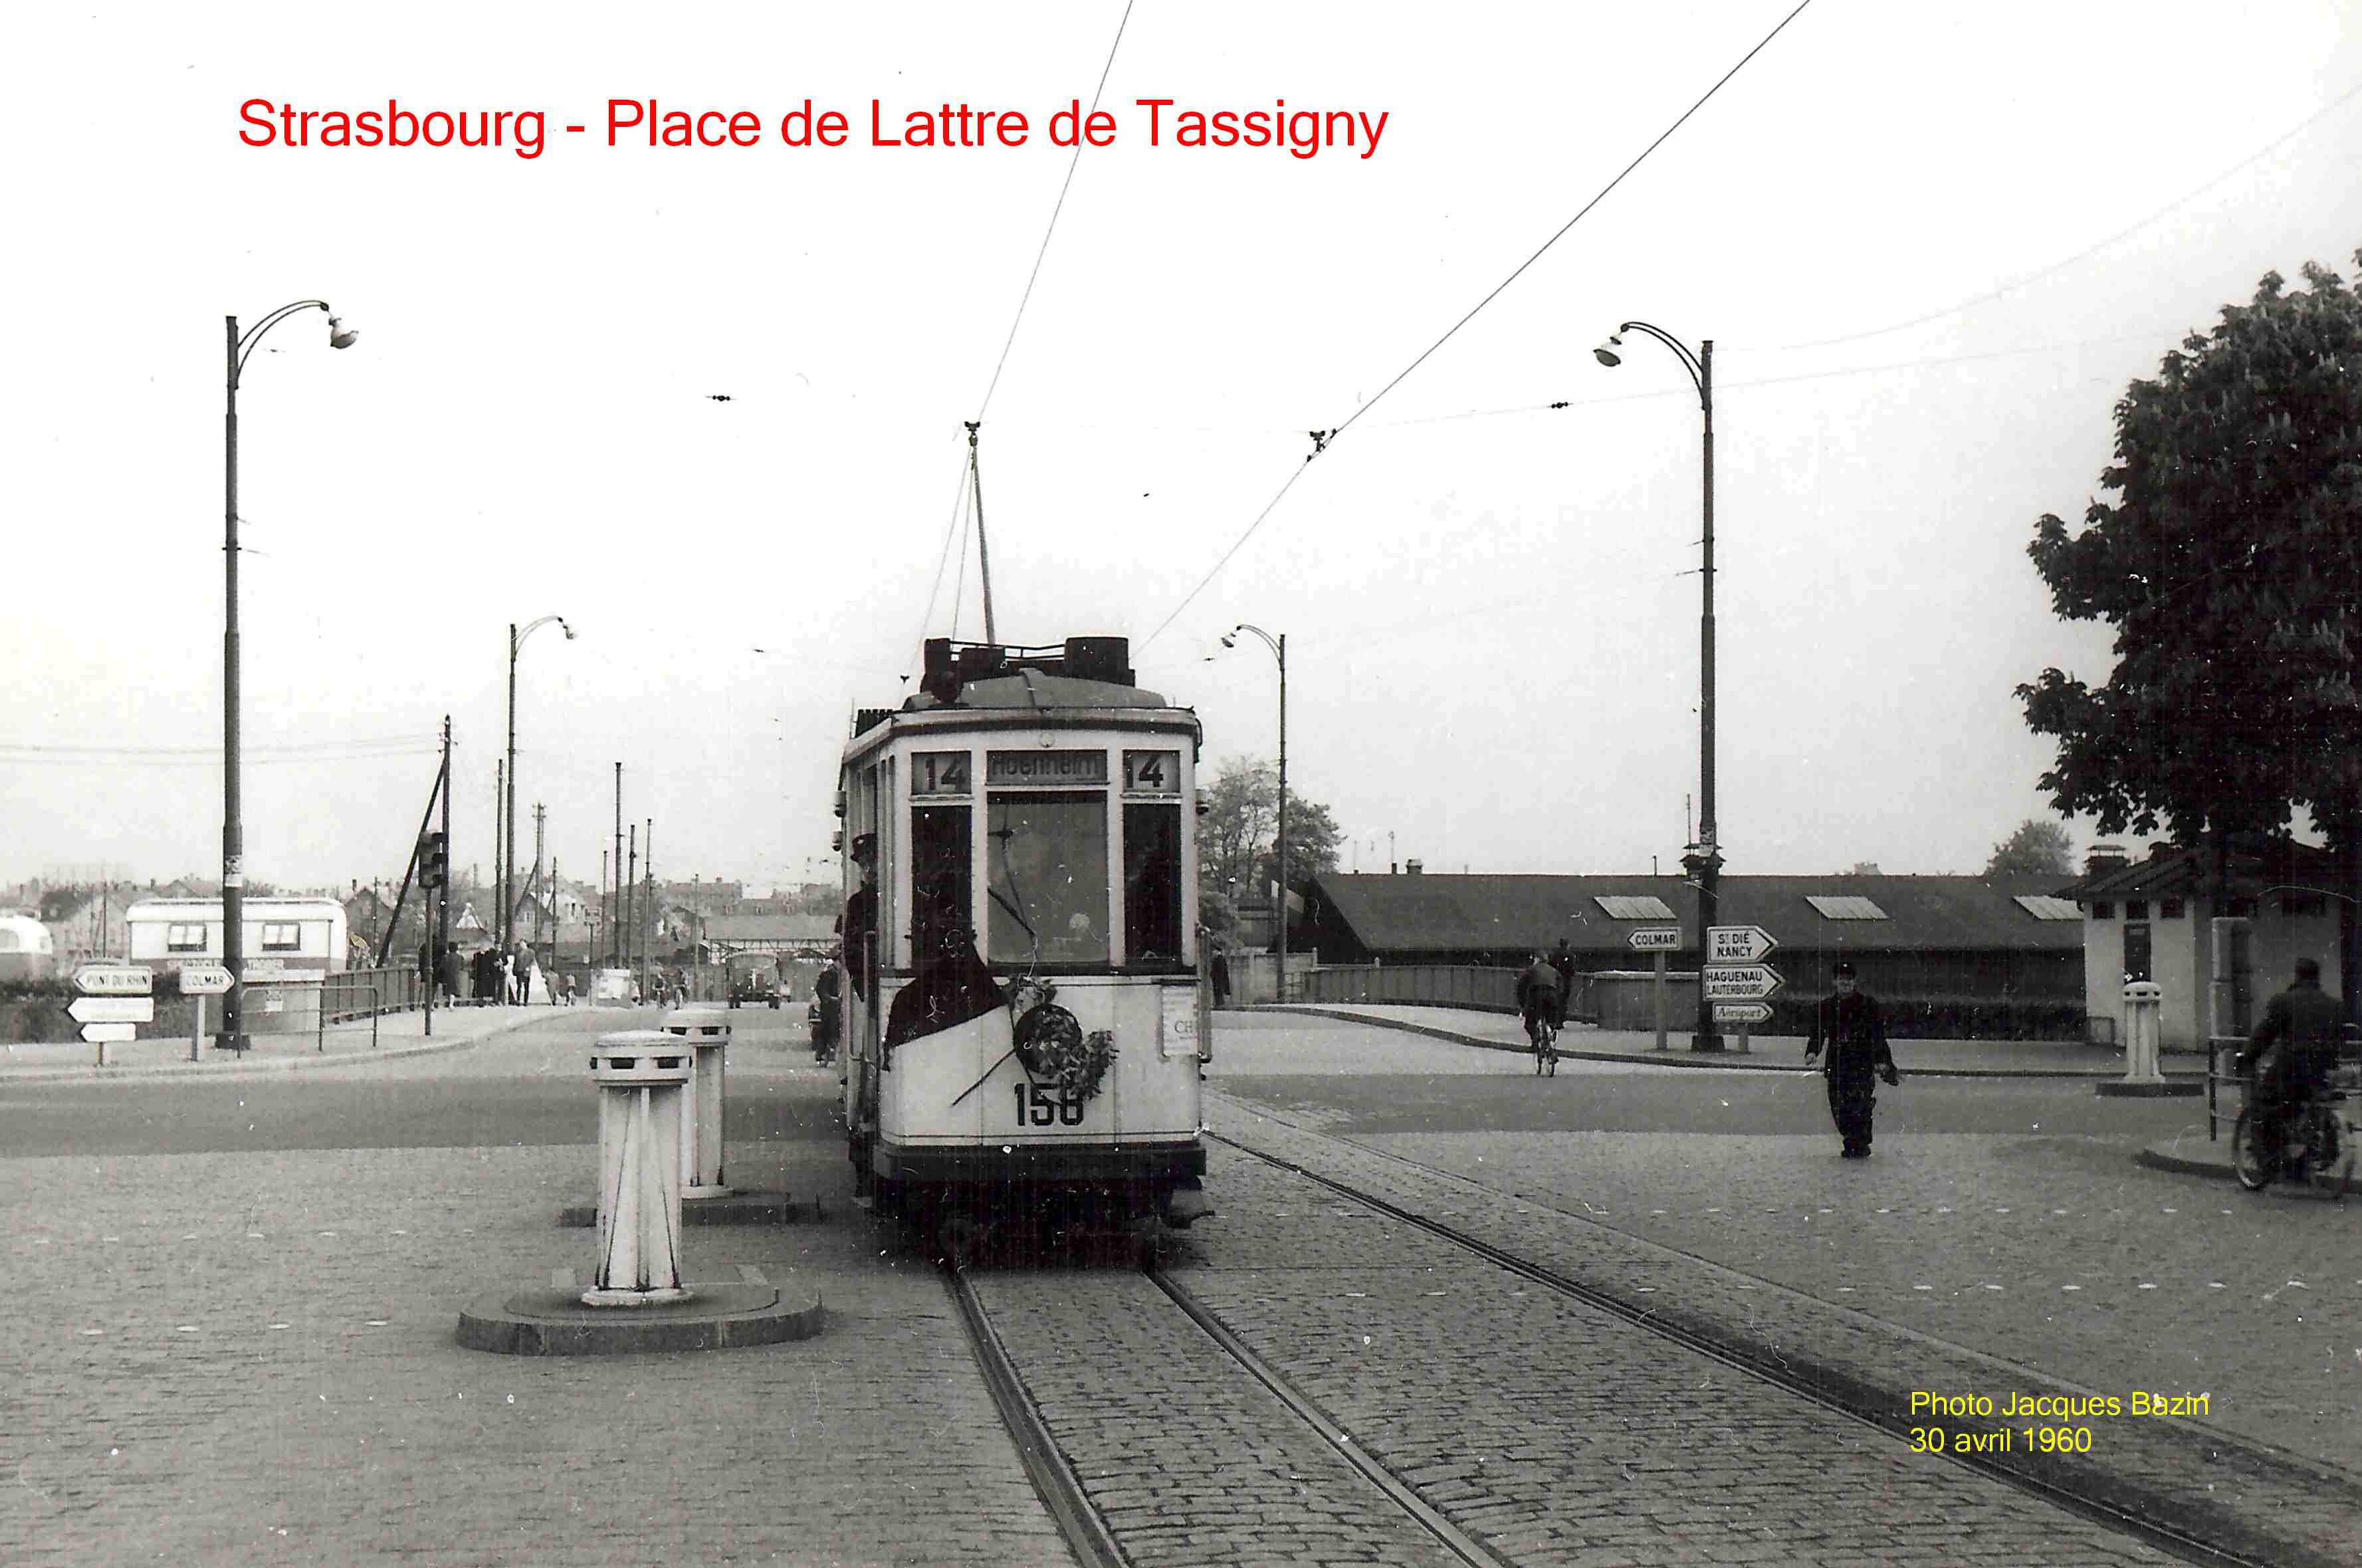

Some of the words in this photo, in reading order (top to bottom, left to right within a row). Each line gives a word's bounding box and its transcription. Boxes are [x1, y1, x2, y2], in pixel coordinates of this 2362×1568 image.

[925, 757, 966, 791] 14
[1127, 753, 1163, 787] 14
[1635, 934, 1676, 945] COLMAR
[1732, 931, 1750, 943] DIÉ
[1717, 946, 1753, 957] NANCY
[86, 975, 109, 986] PONT
[112, 975, 124, 986] DU
[126, 975, 148, 986] RHIN
[185, 975, 224, 986] COLMAR
[1706, 971, 1763, 982] HAGUENAU
[1707, 984, 1763, 995] LAUTERBOURG
